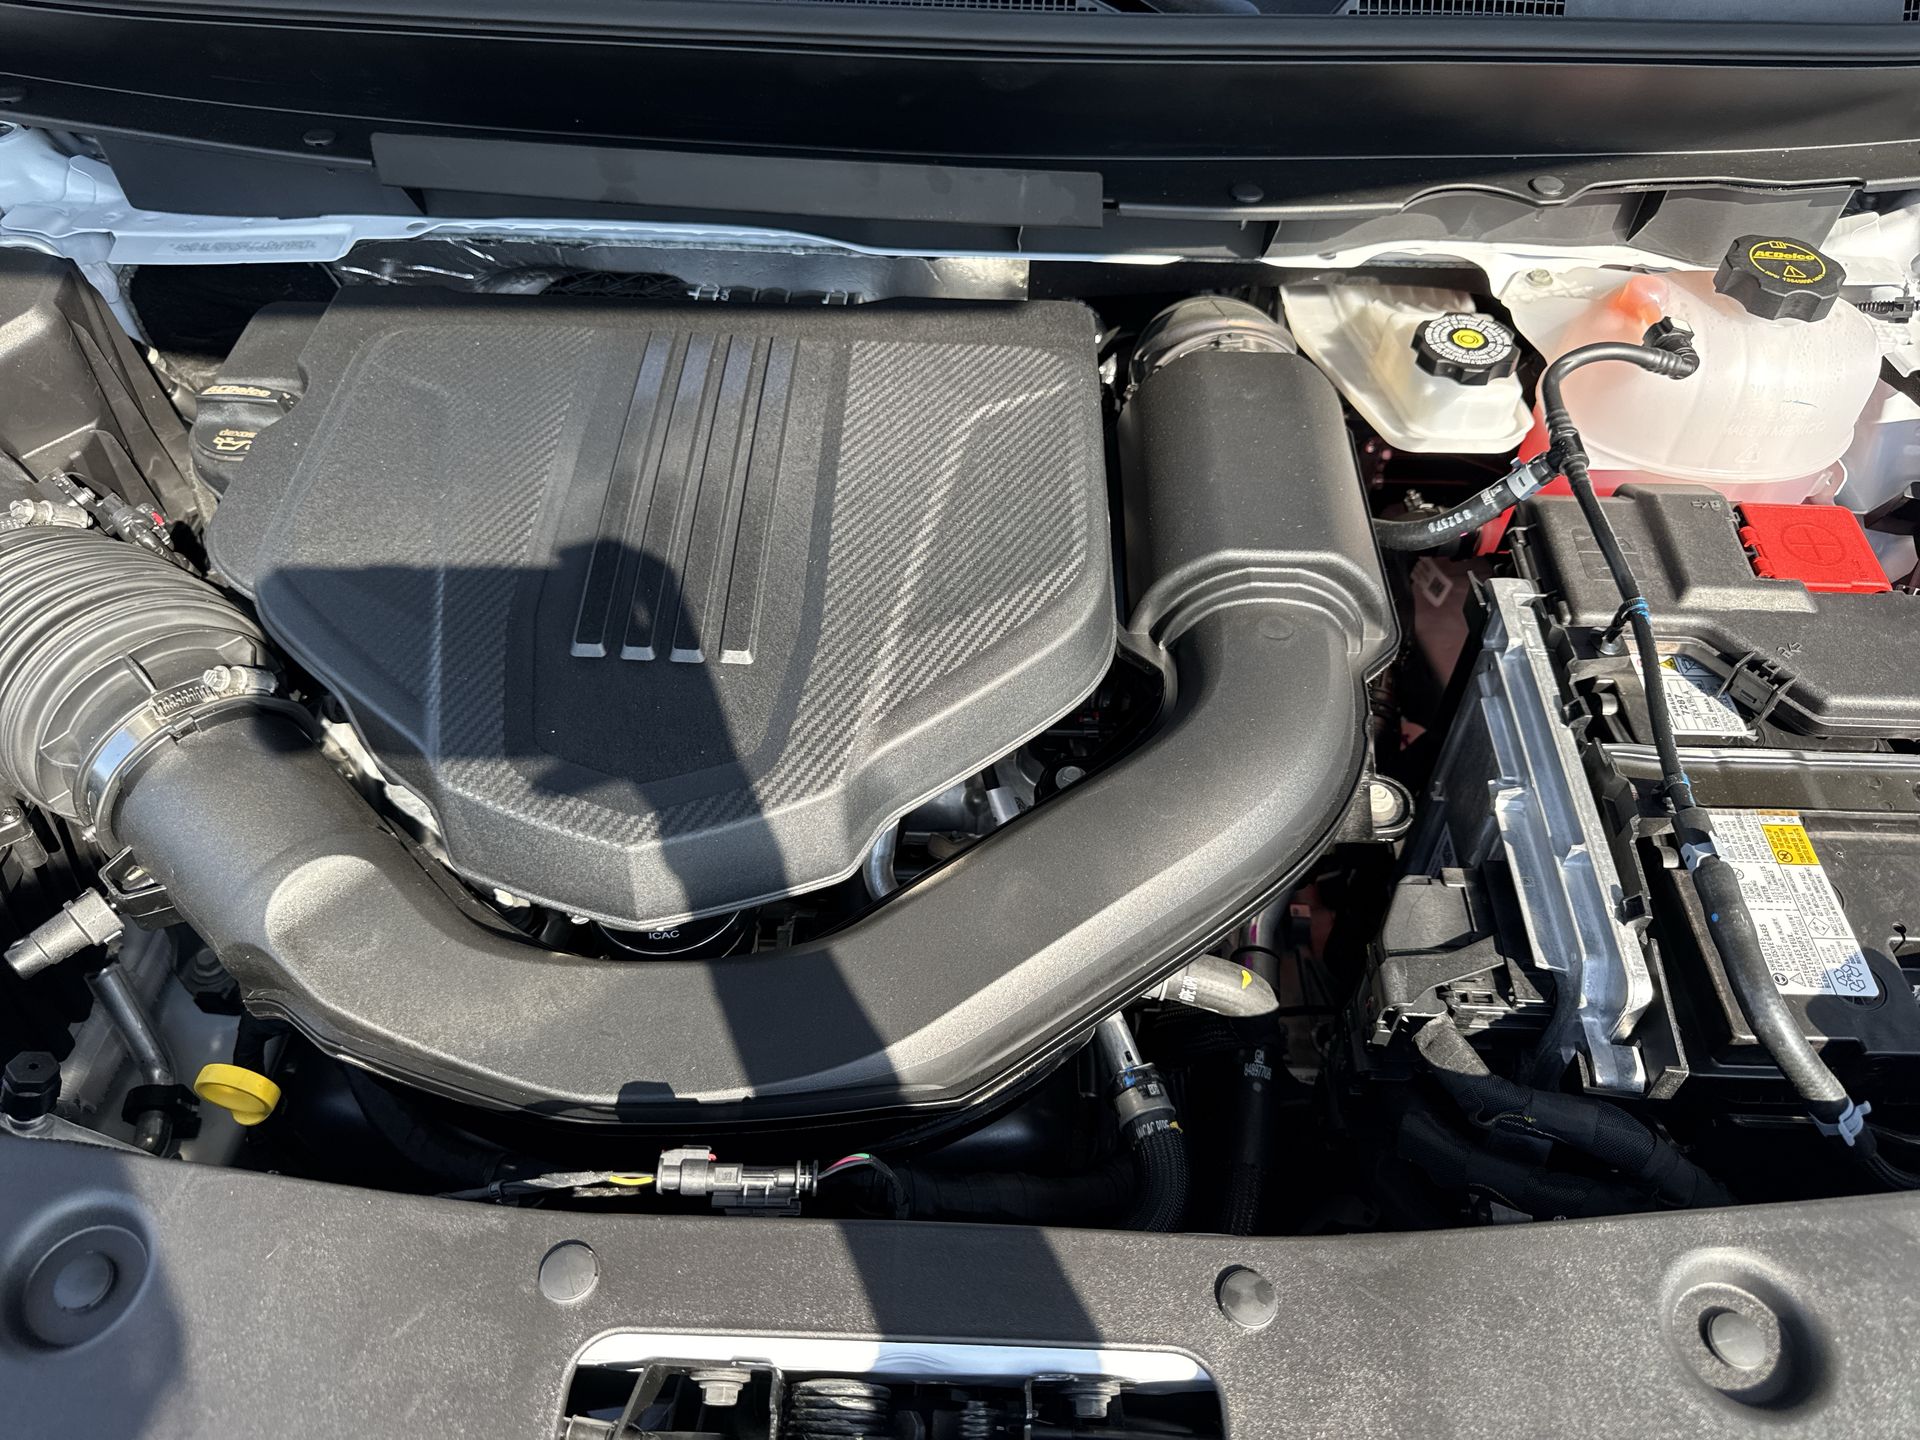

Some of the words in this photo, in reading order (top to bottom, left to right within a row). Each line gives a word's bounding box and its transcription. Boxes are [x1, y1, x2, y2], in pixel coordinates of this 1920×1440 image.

[1754, 250, 1815, 261] ACDelco
[201, 385, 271, 398] ACDelco
[1674, 694, 1691, 715] 7287
[1712, 716, 1720, 727] 730
[1758, 923, 1771, 940] GASES
[1785, 914, 1800, 935] PEUVENT
[1766, 942, 1785, 970] EXPLOSIVE
[1775, 944, 1787, 959] CAUSE
[1793, 949, 1803, 959] LES
[1795, 936, 1813, 964] EXPLOSIFS
[1763, 952, 1777, 970] SHIELD
[1783, 944, 1800, 971] BLINDNESS
[1782, 961, 1792, 970] CAN
[1808, 966, 1819, 976] GAZ
[1813, 977, 1824, 988] LES
[1254, 1049, 1265, 1063] GM
